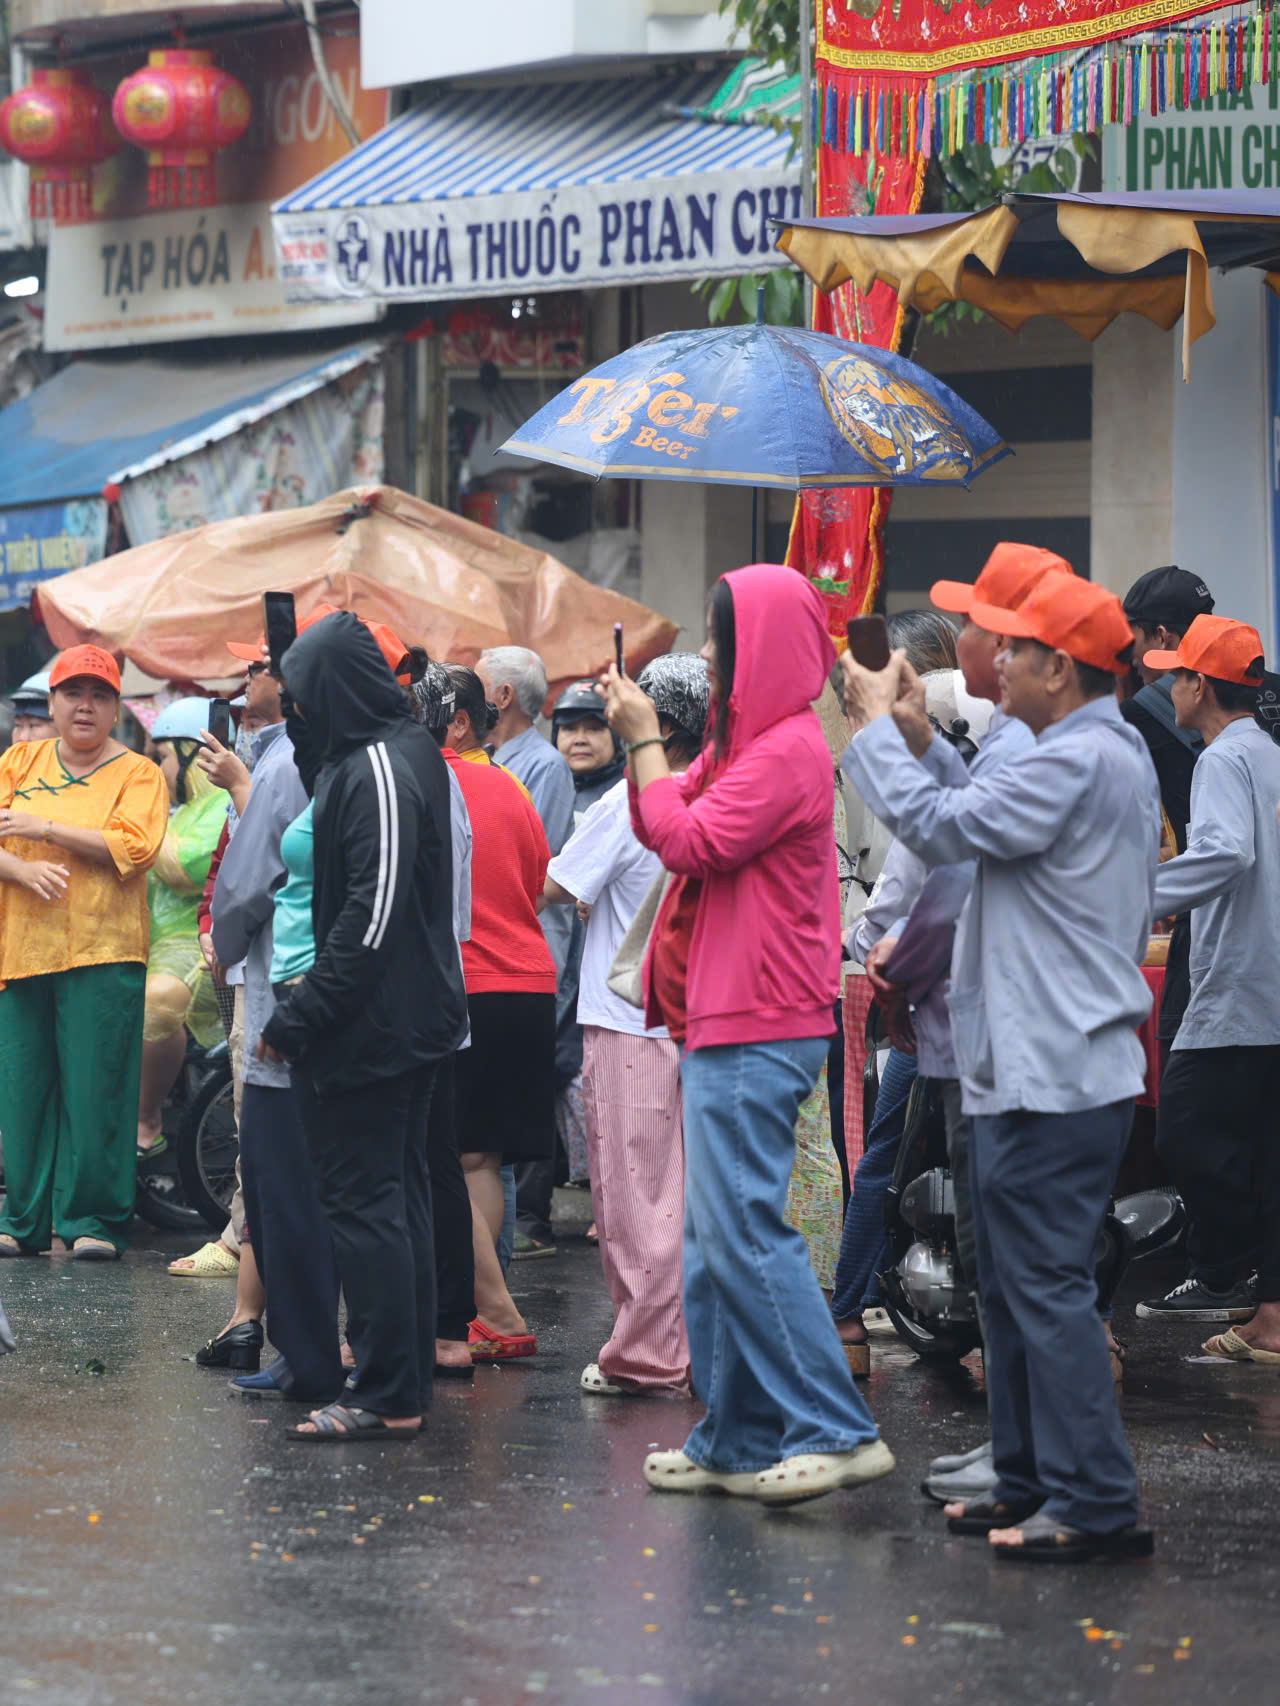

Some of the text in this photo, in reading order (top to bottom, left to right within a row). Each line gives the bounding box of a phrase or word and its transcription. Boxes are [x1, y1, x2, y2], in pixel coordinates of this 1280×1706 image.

[1143, 126, 1232, 191] PHAN
[101, 231, 156, 312] TẠP
[163, 206, 231, 289] HÓA
[383, 213, 453, 287] NHÀ
[467, 193, 581, 282] THUỐC
[599, 192, 717, 267] PHAN
[630, 425, 700, 459] Beer
